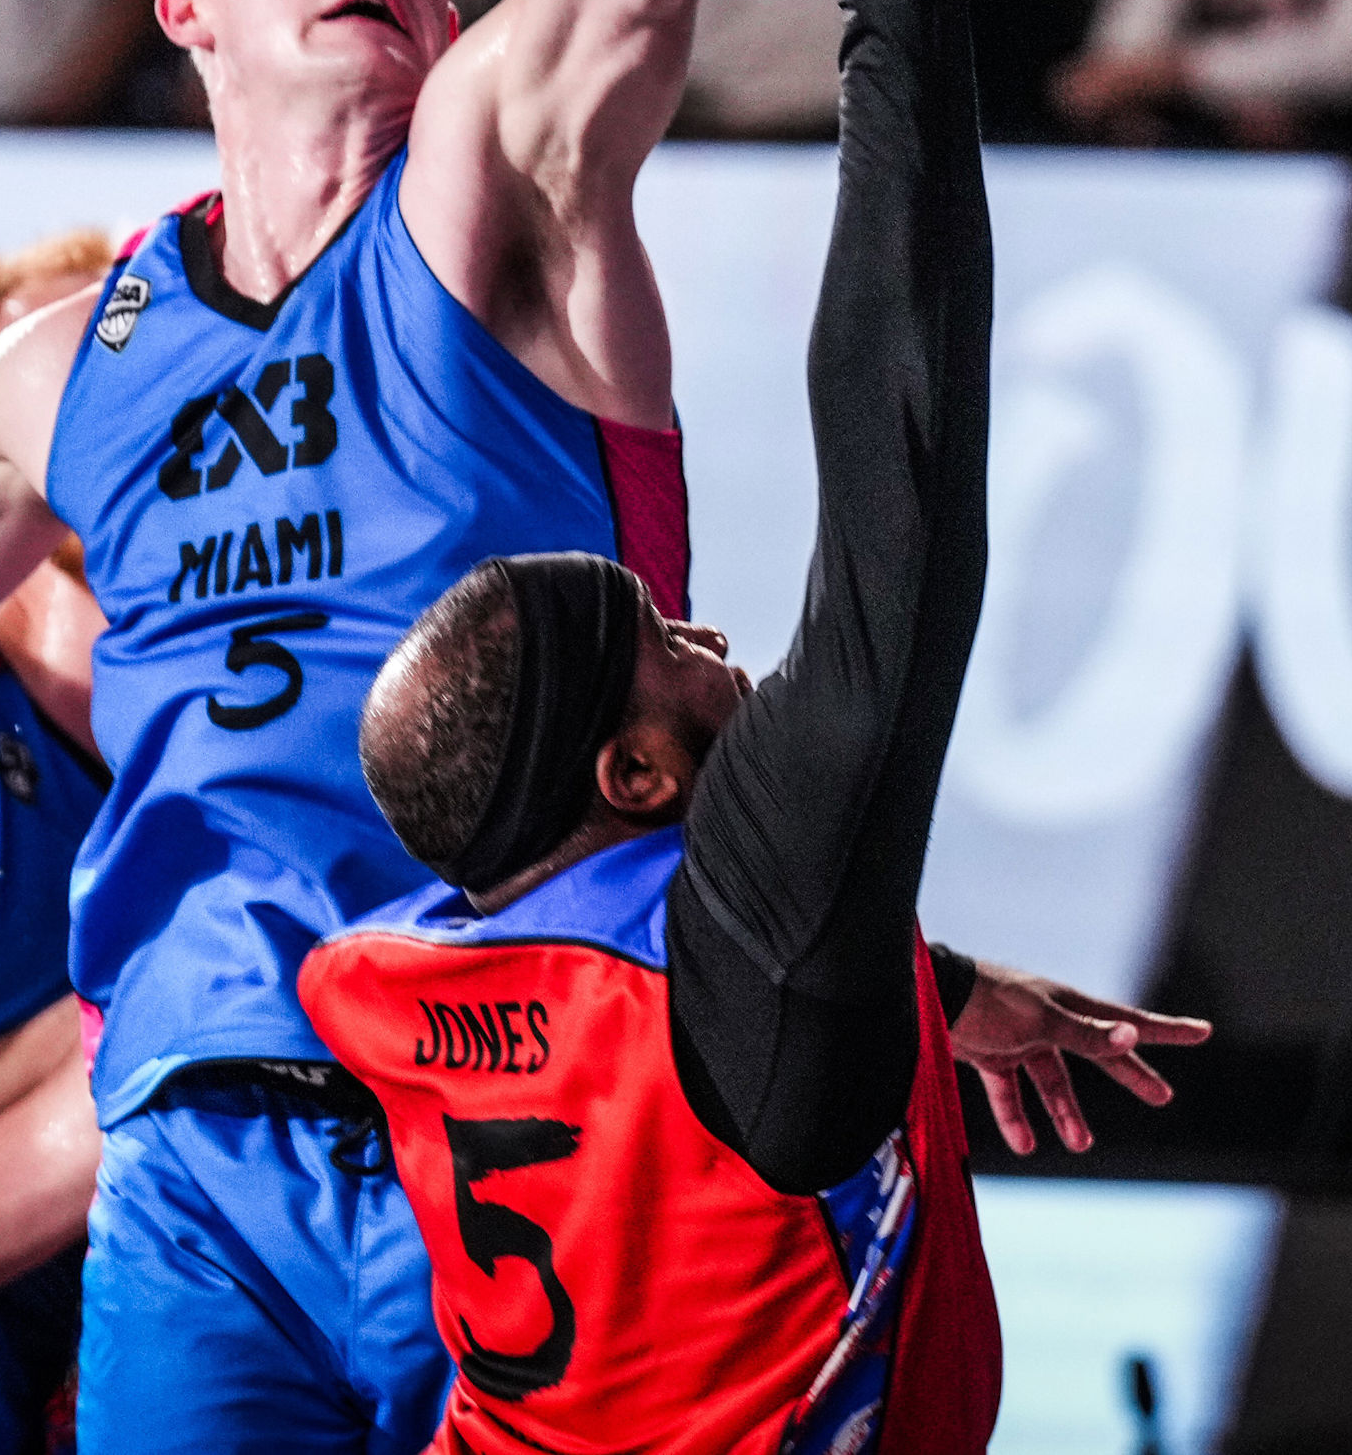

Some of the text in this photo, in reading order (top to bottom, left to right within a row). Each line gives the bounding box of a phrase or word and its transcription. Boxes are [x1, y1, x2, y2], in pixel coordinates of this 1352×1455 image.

[167, 510, 344, 603] MIAMI
[206, 612, 331, 732] 5
[414, 999, 550, 1075] JONES
[441, 1111, 583, 1403] 5
